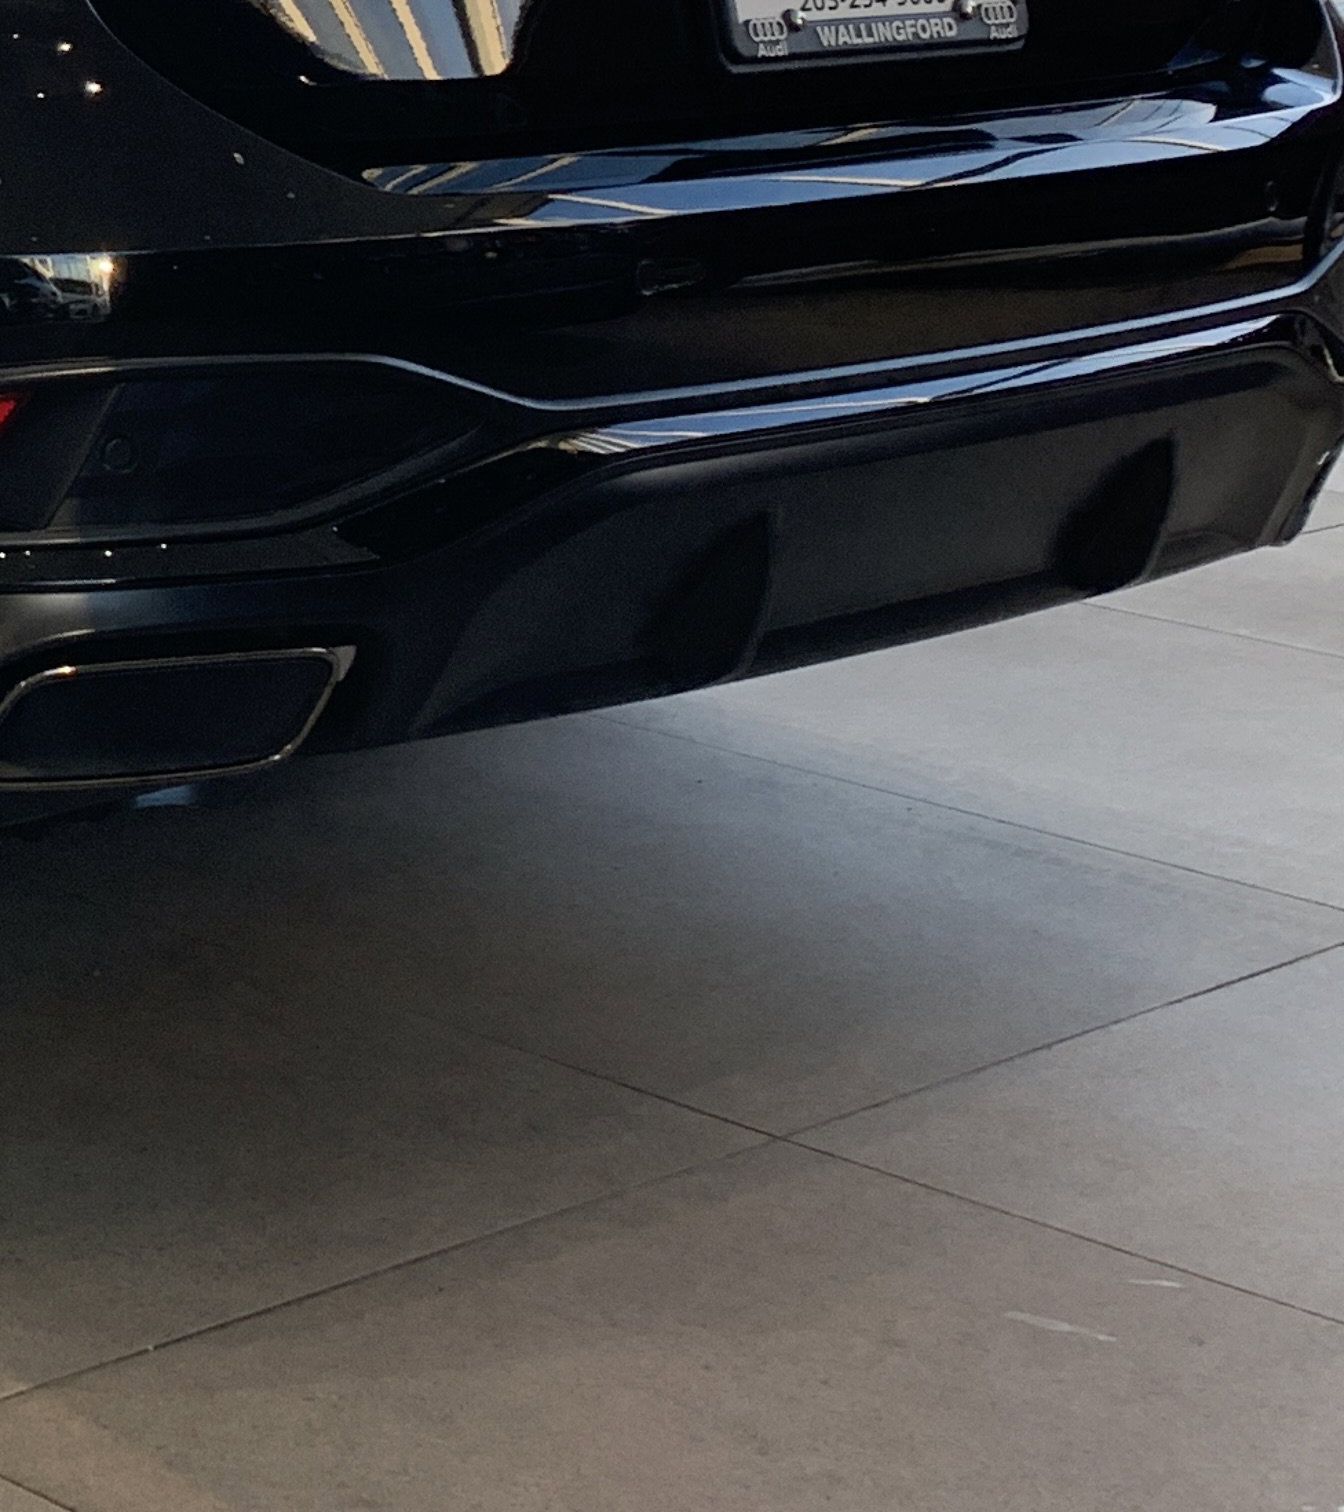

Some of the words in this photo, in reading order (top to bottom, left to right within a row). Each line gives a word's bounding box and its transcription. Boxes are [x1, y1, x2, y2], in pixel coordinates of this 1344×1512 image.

[816, 17, 958, 48] WALLINGFORD
[989, 23, 1018, 40] Audi
[757, 39, 789, 58] Audi
